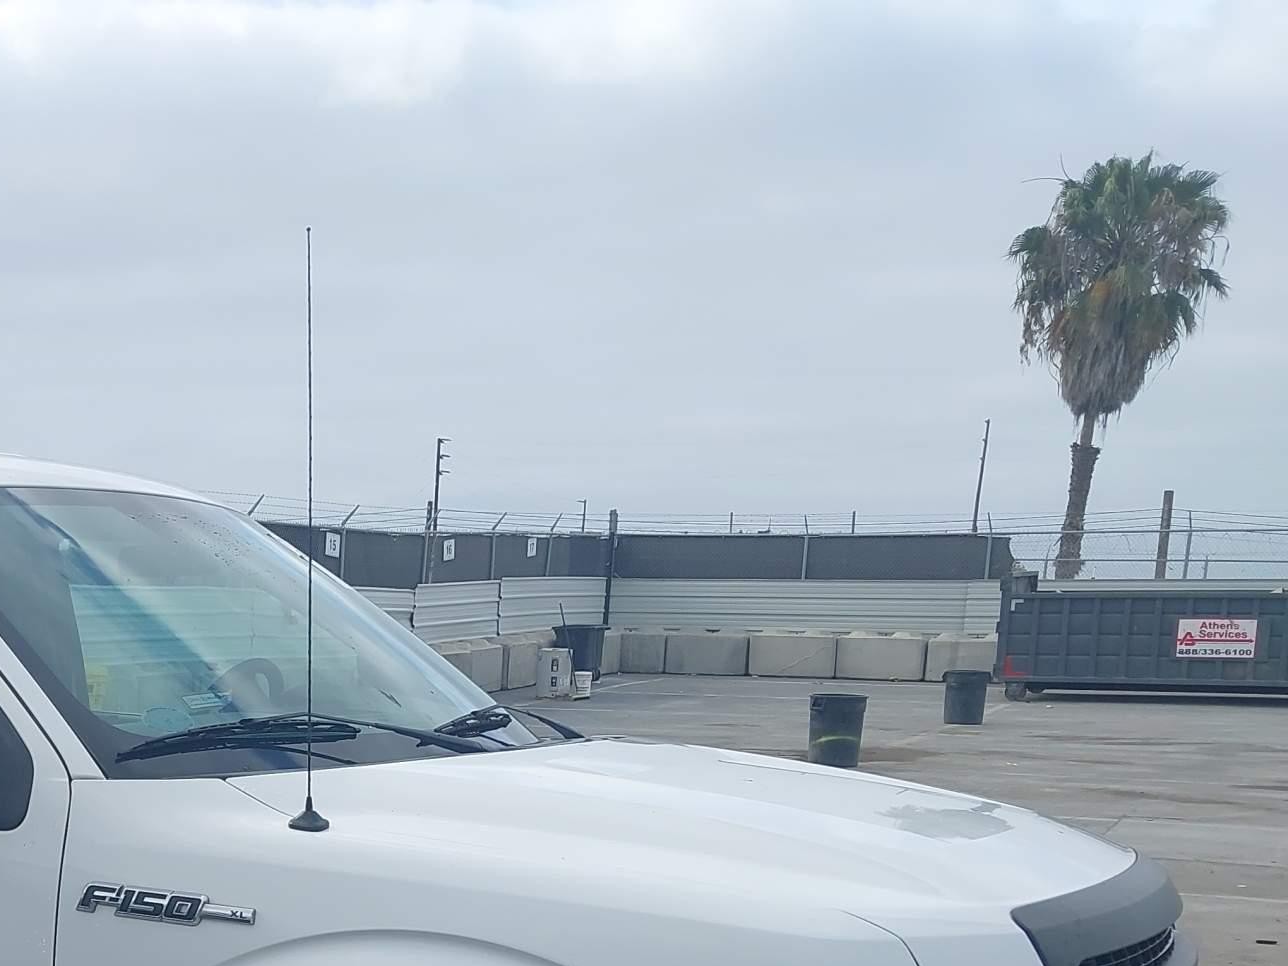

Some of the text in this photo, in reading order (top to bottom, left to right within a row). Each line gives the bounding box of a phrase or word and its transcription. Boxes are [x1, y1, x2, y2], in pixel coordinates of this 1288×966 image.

[329, 537, 337, 552] 15
[1199, 621, 1240, 630] Athens
[1198, 630, 1248, 639] Services
[77, 883, 248, 924] F-150 XL
